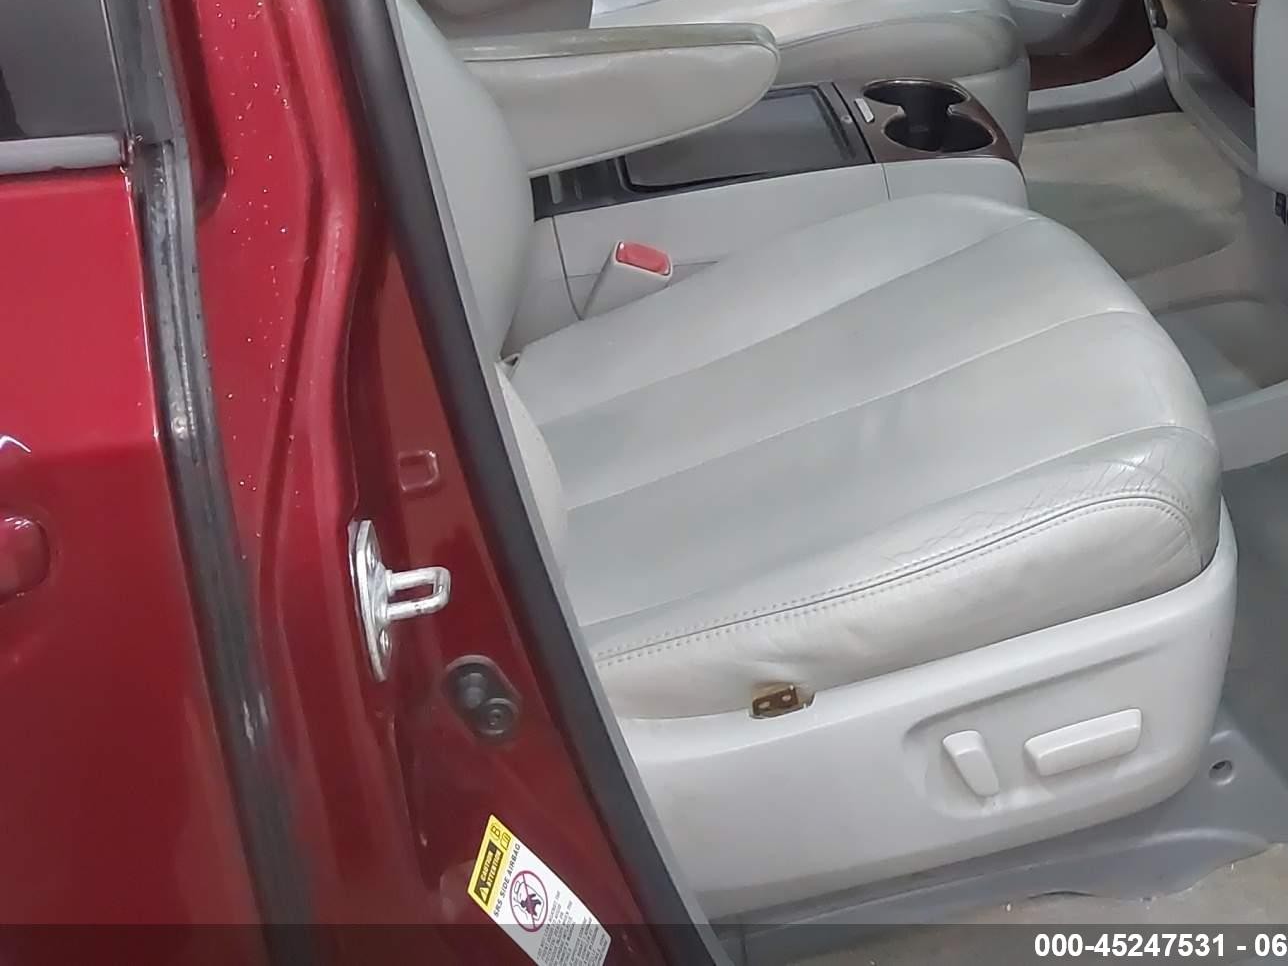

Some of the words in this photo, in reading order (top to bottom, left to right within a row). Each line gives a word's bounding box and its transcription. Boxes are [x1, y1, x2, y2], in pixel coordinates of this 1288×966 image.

[480, 849, 494, 882] CAUTION
[486, 848, 502, 889] ATTENTION
[493, 898, 503, 918] SRS
[499, 879, 510, 899] SIDE
[507, 843, 521, 877] AIRBAG
